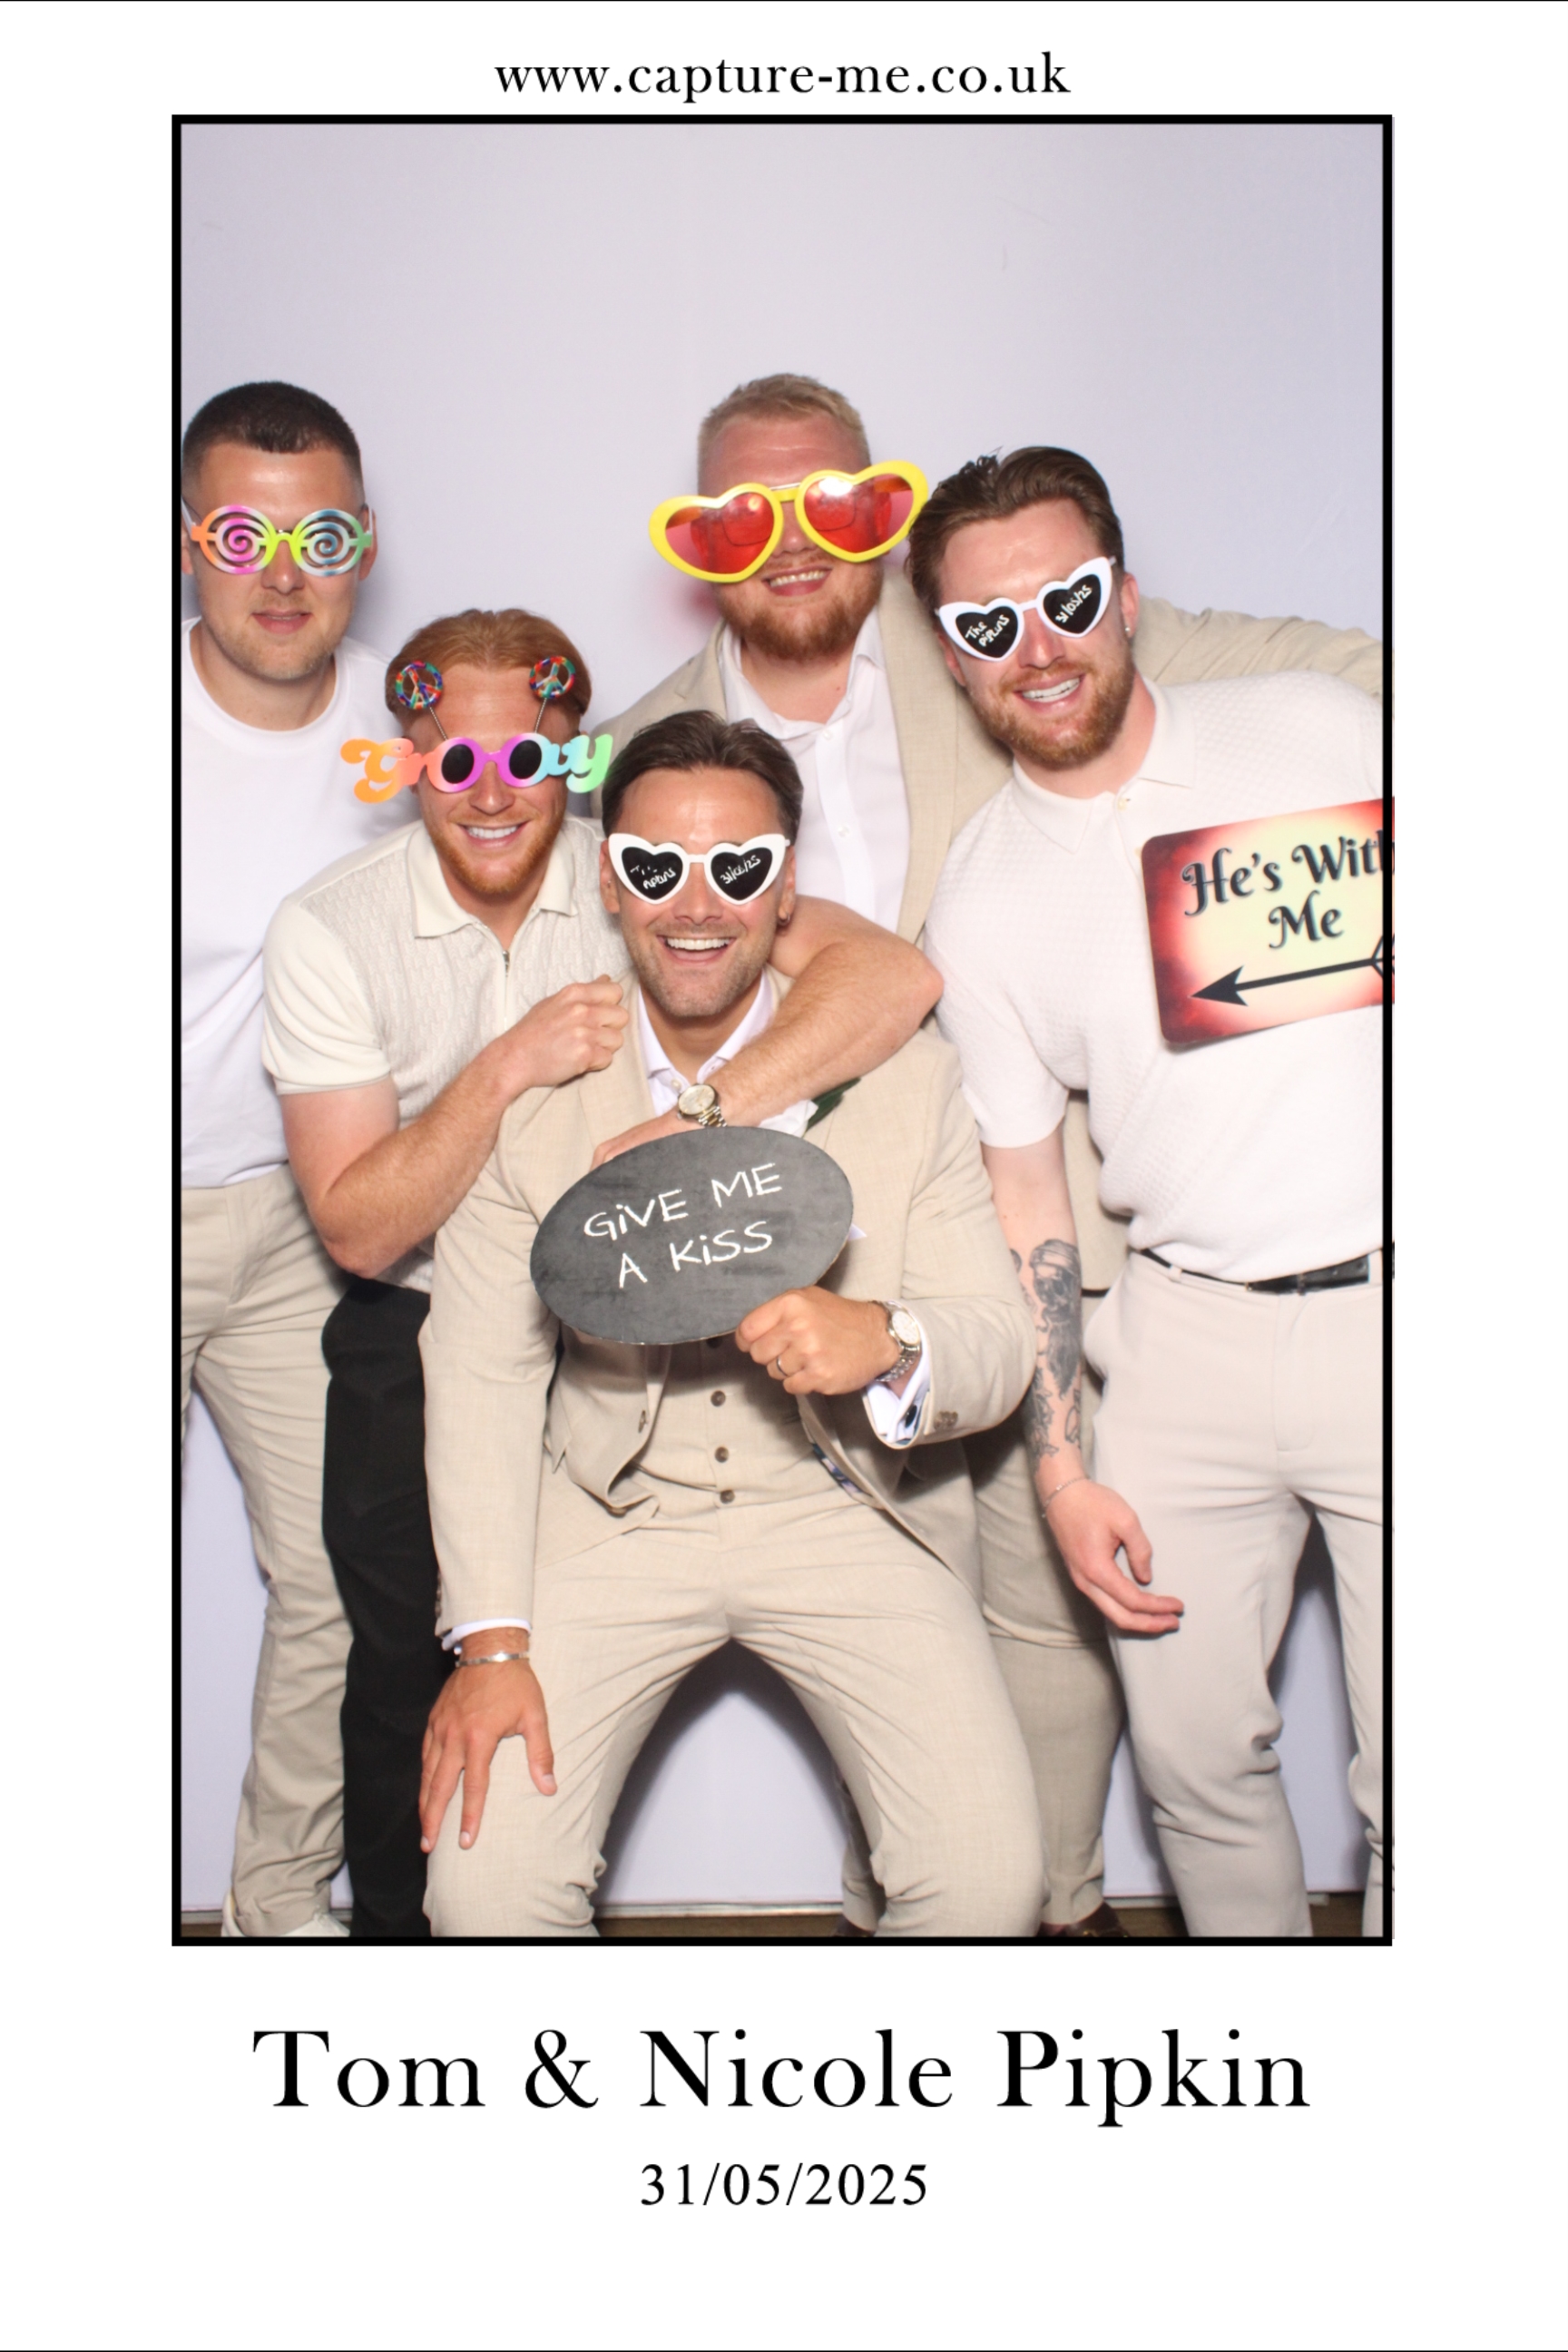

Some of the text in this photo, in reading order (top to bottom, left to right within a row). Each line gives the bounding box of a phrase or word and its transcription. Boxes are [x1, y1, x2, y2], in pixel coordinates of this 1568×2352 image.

[965, 622, 987, 639] The
[1181, 847, 1283, 917] He's
[1267, 889, 1345, 949] Me
[710, 1162, 783, 1209] ME
[619, 1252, 648, 1289] A
